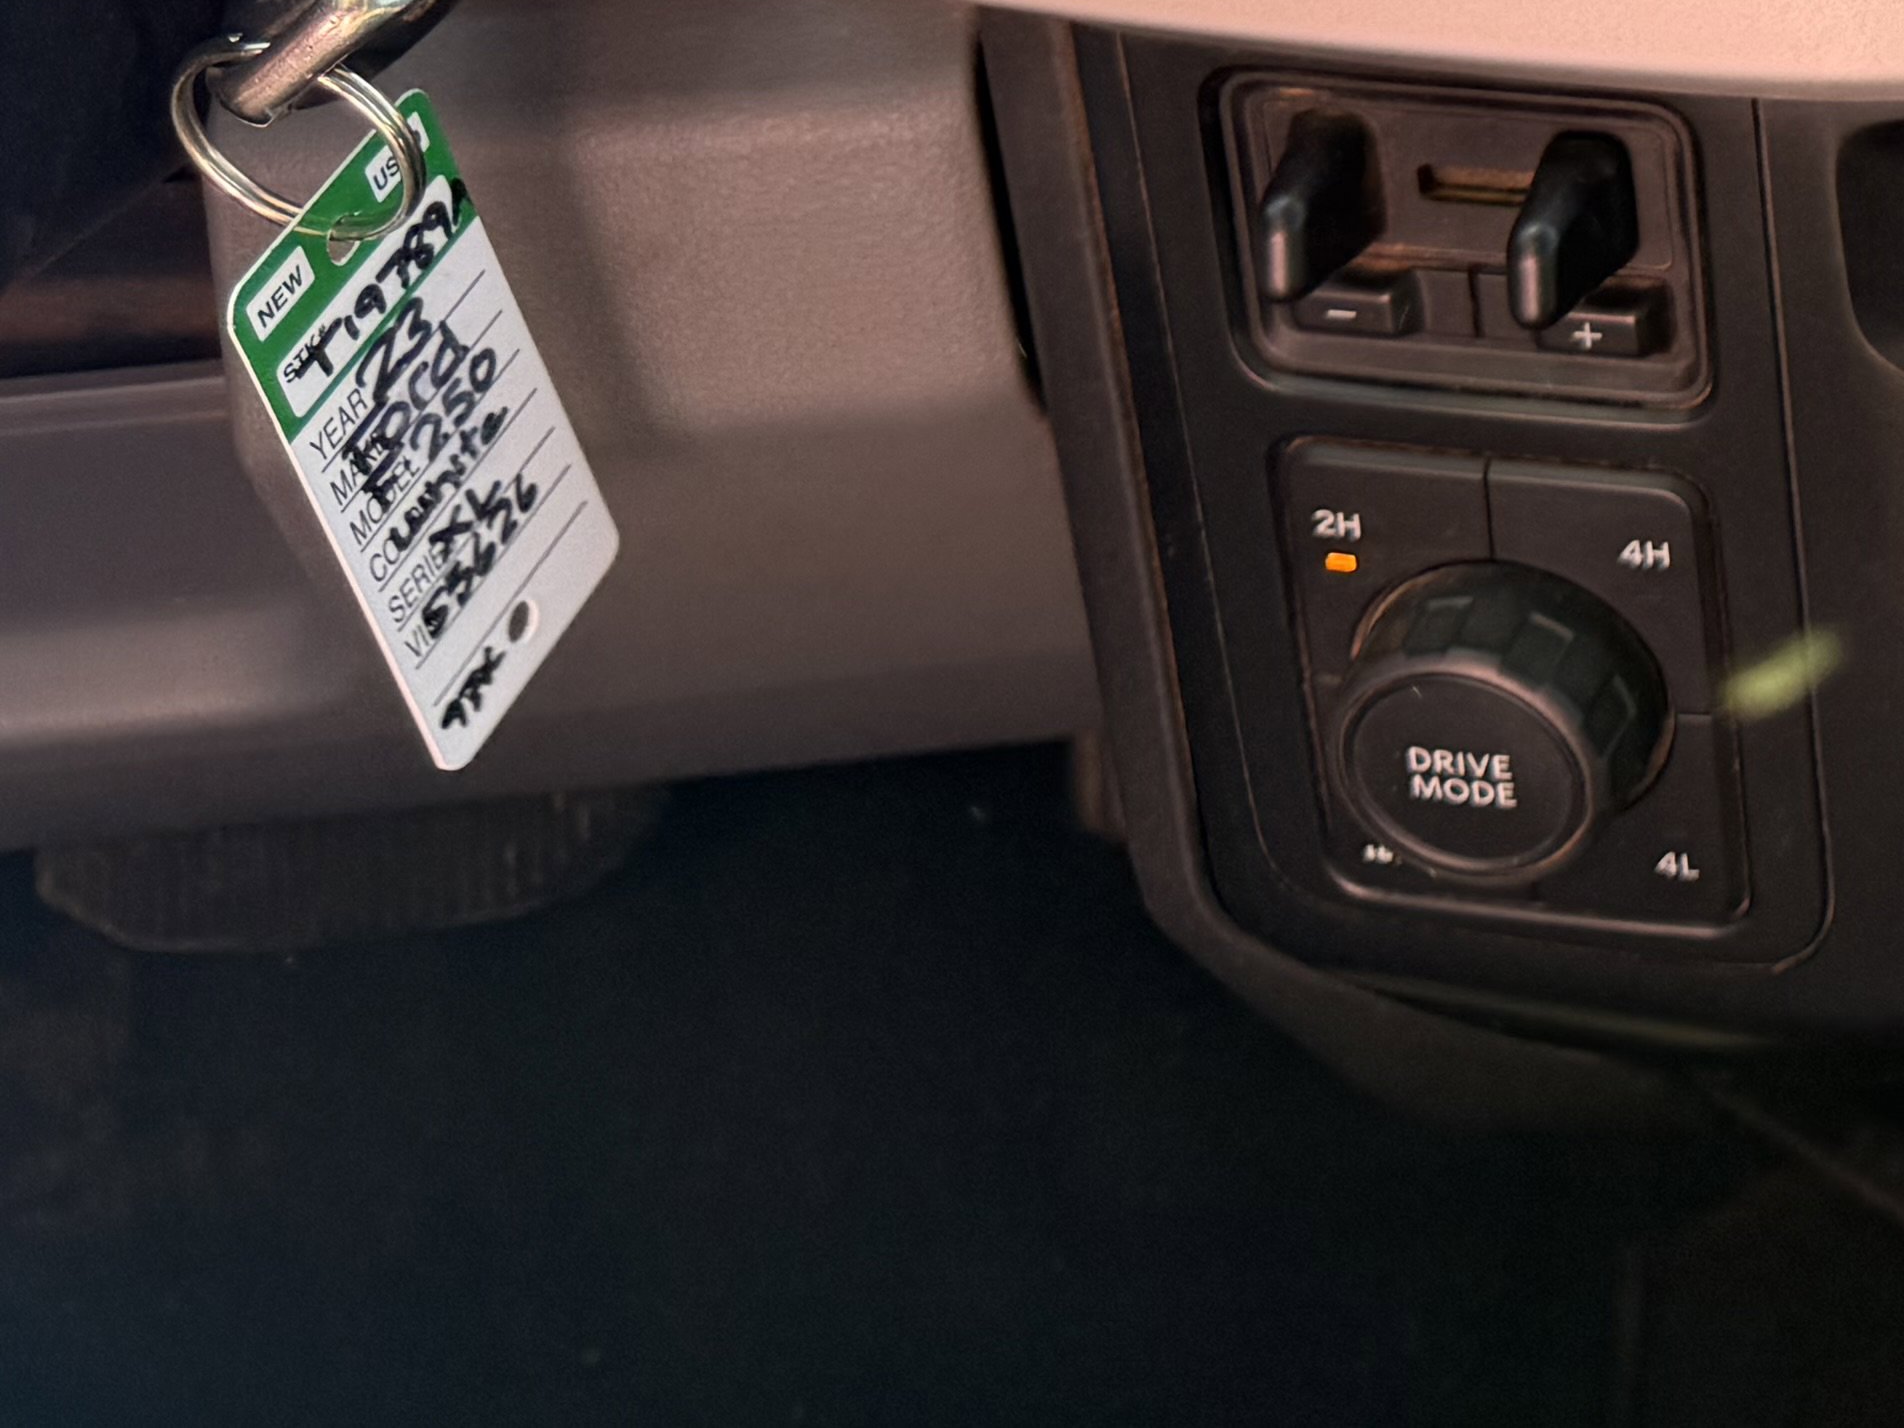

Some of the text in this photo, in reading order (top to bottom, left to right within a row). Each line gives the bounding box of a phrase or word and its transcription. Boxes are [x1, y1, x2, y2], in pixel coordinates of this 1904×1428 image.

[256, 264, 304, 329] NEW
[310, 388, 369, 460] YEAR
[1311, 508, 1362, 542] 2H
[1617, 538, 1671, 570] 4H
[1406, 745, 1513, 782] DRIVE
[1409, 773, 1518, 810] MODE
[1655, 851, 1700, 882] 4L
